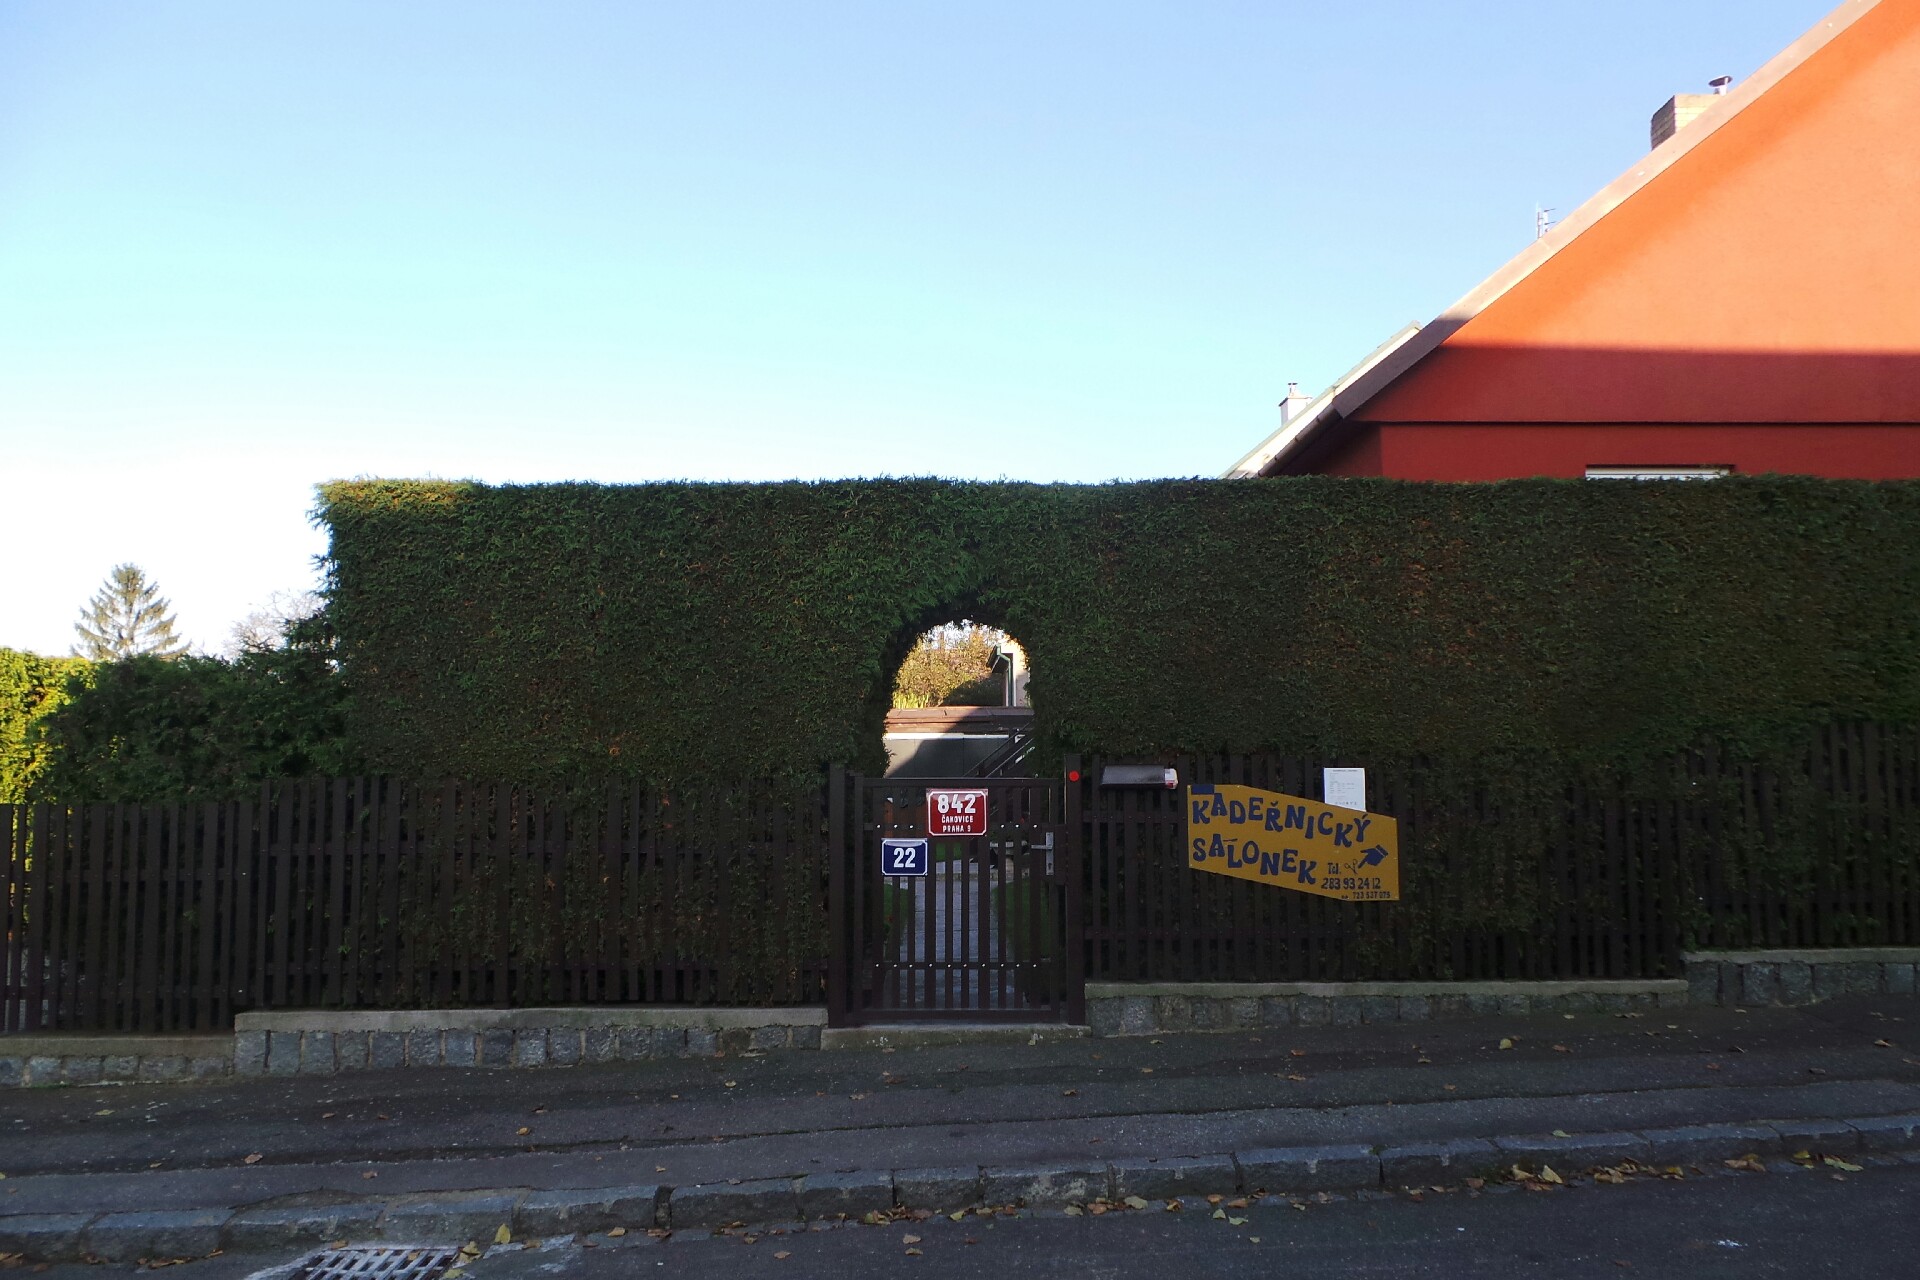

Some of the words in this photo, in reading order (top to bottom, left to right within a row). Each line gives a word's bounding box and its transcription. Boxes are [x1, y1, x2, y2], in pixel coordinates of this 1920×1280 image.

[937, 793, 976, 814] 842
[941, 814, 974, 823] ČAKOVICE
[1192, 793, 1371, 848] KADEŘNICKÝ
[893, 847, 916, 868] 22
[1321, 877, 1341, 890] 283
[1342, 877, 1356, 890] 93
[1357, 877, 1370, 890] 24
[1372, 877, 1381, 890] 12
